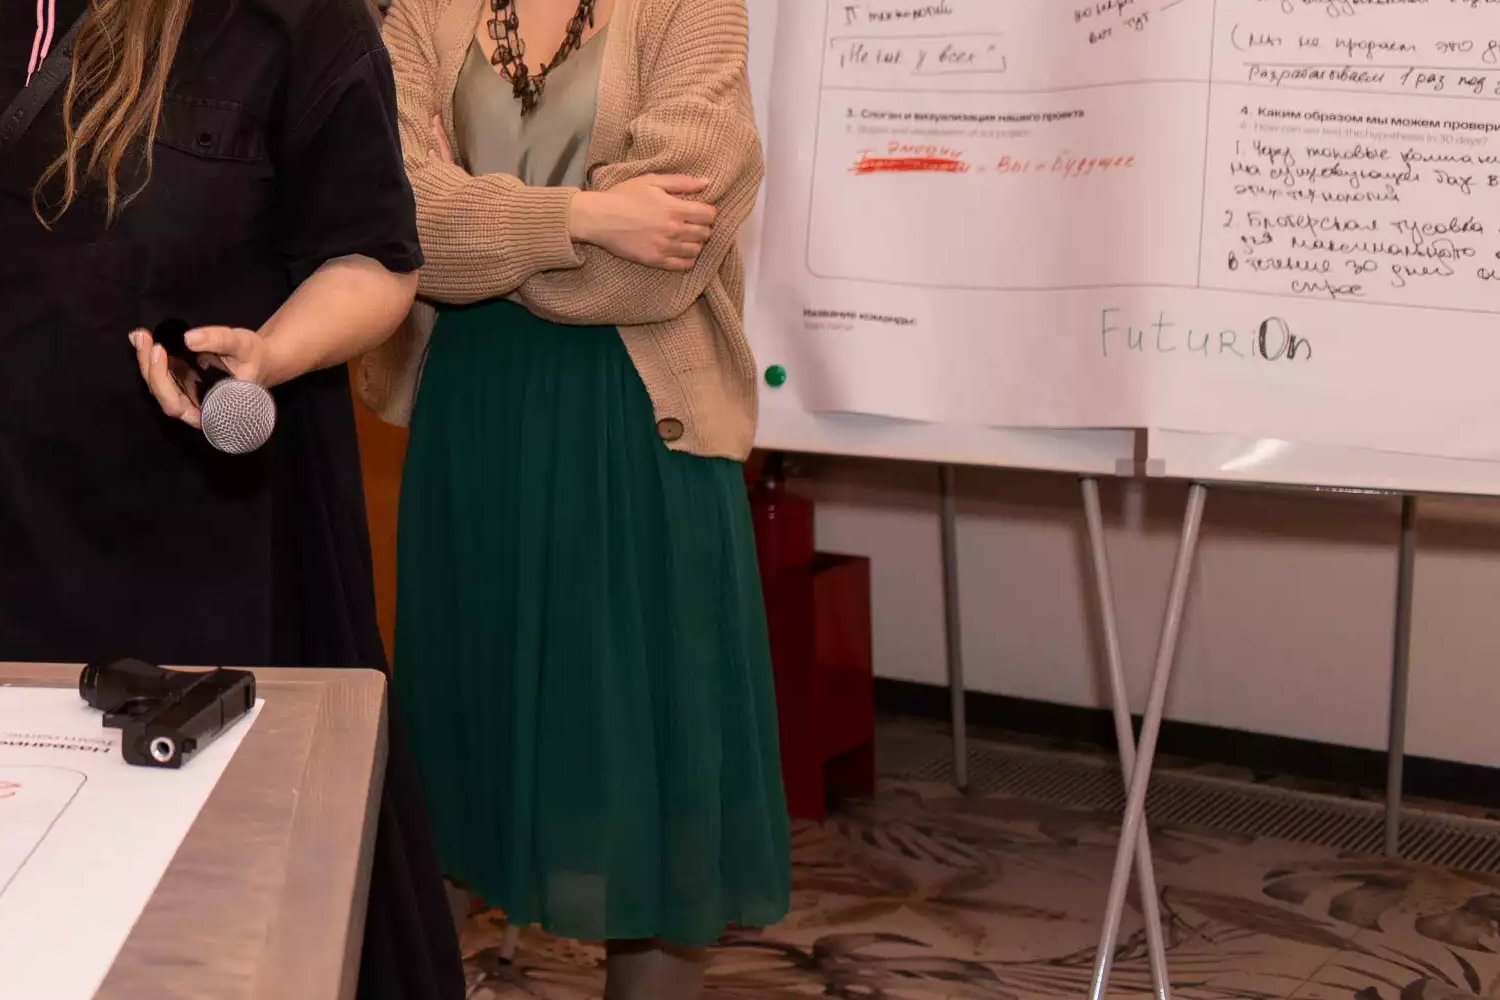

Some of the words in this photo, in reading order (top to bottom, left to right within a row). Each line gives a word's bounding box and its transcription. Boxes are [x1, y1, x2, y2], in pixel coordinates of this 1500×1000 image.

[1258, 107, 1301, 119] Каким
[1304, 110, 1363, 125] образом
[1366, 115, 1388, 125] мы
[1390, 117, 1440, 128] можем
